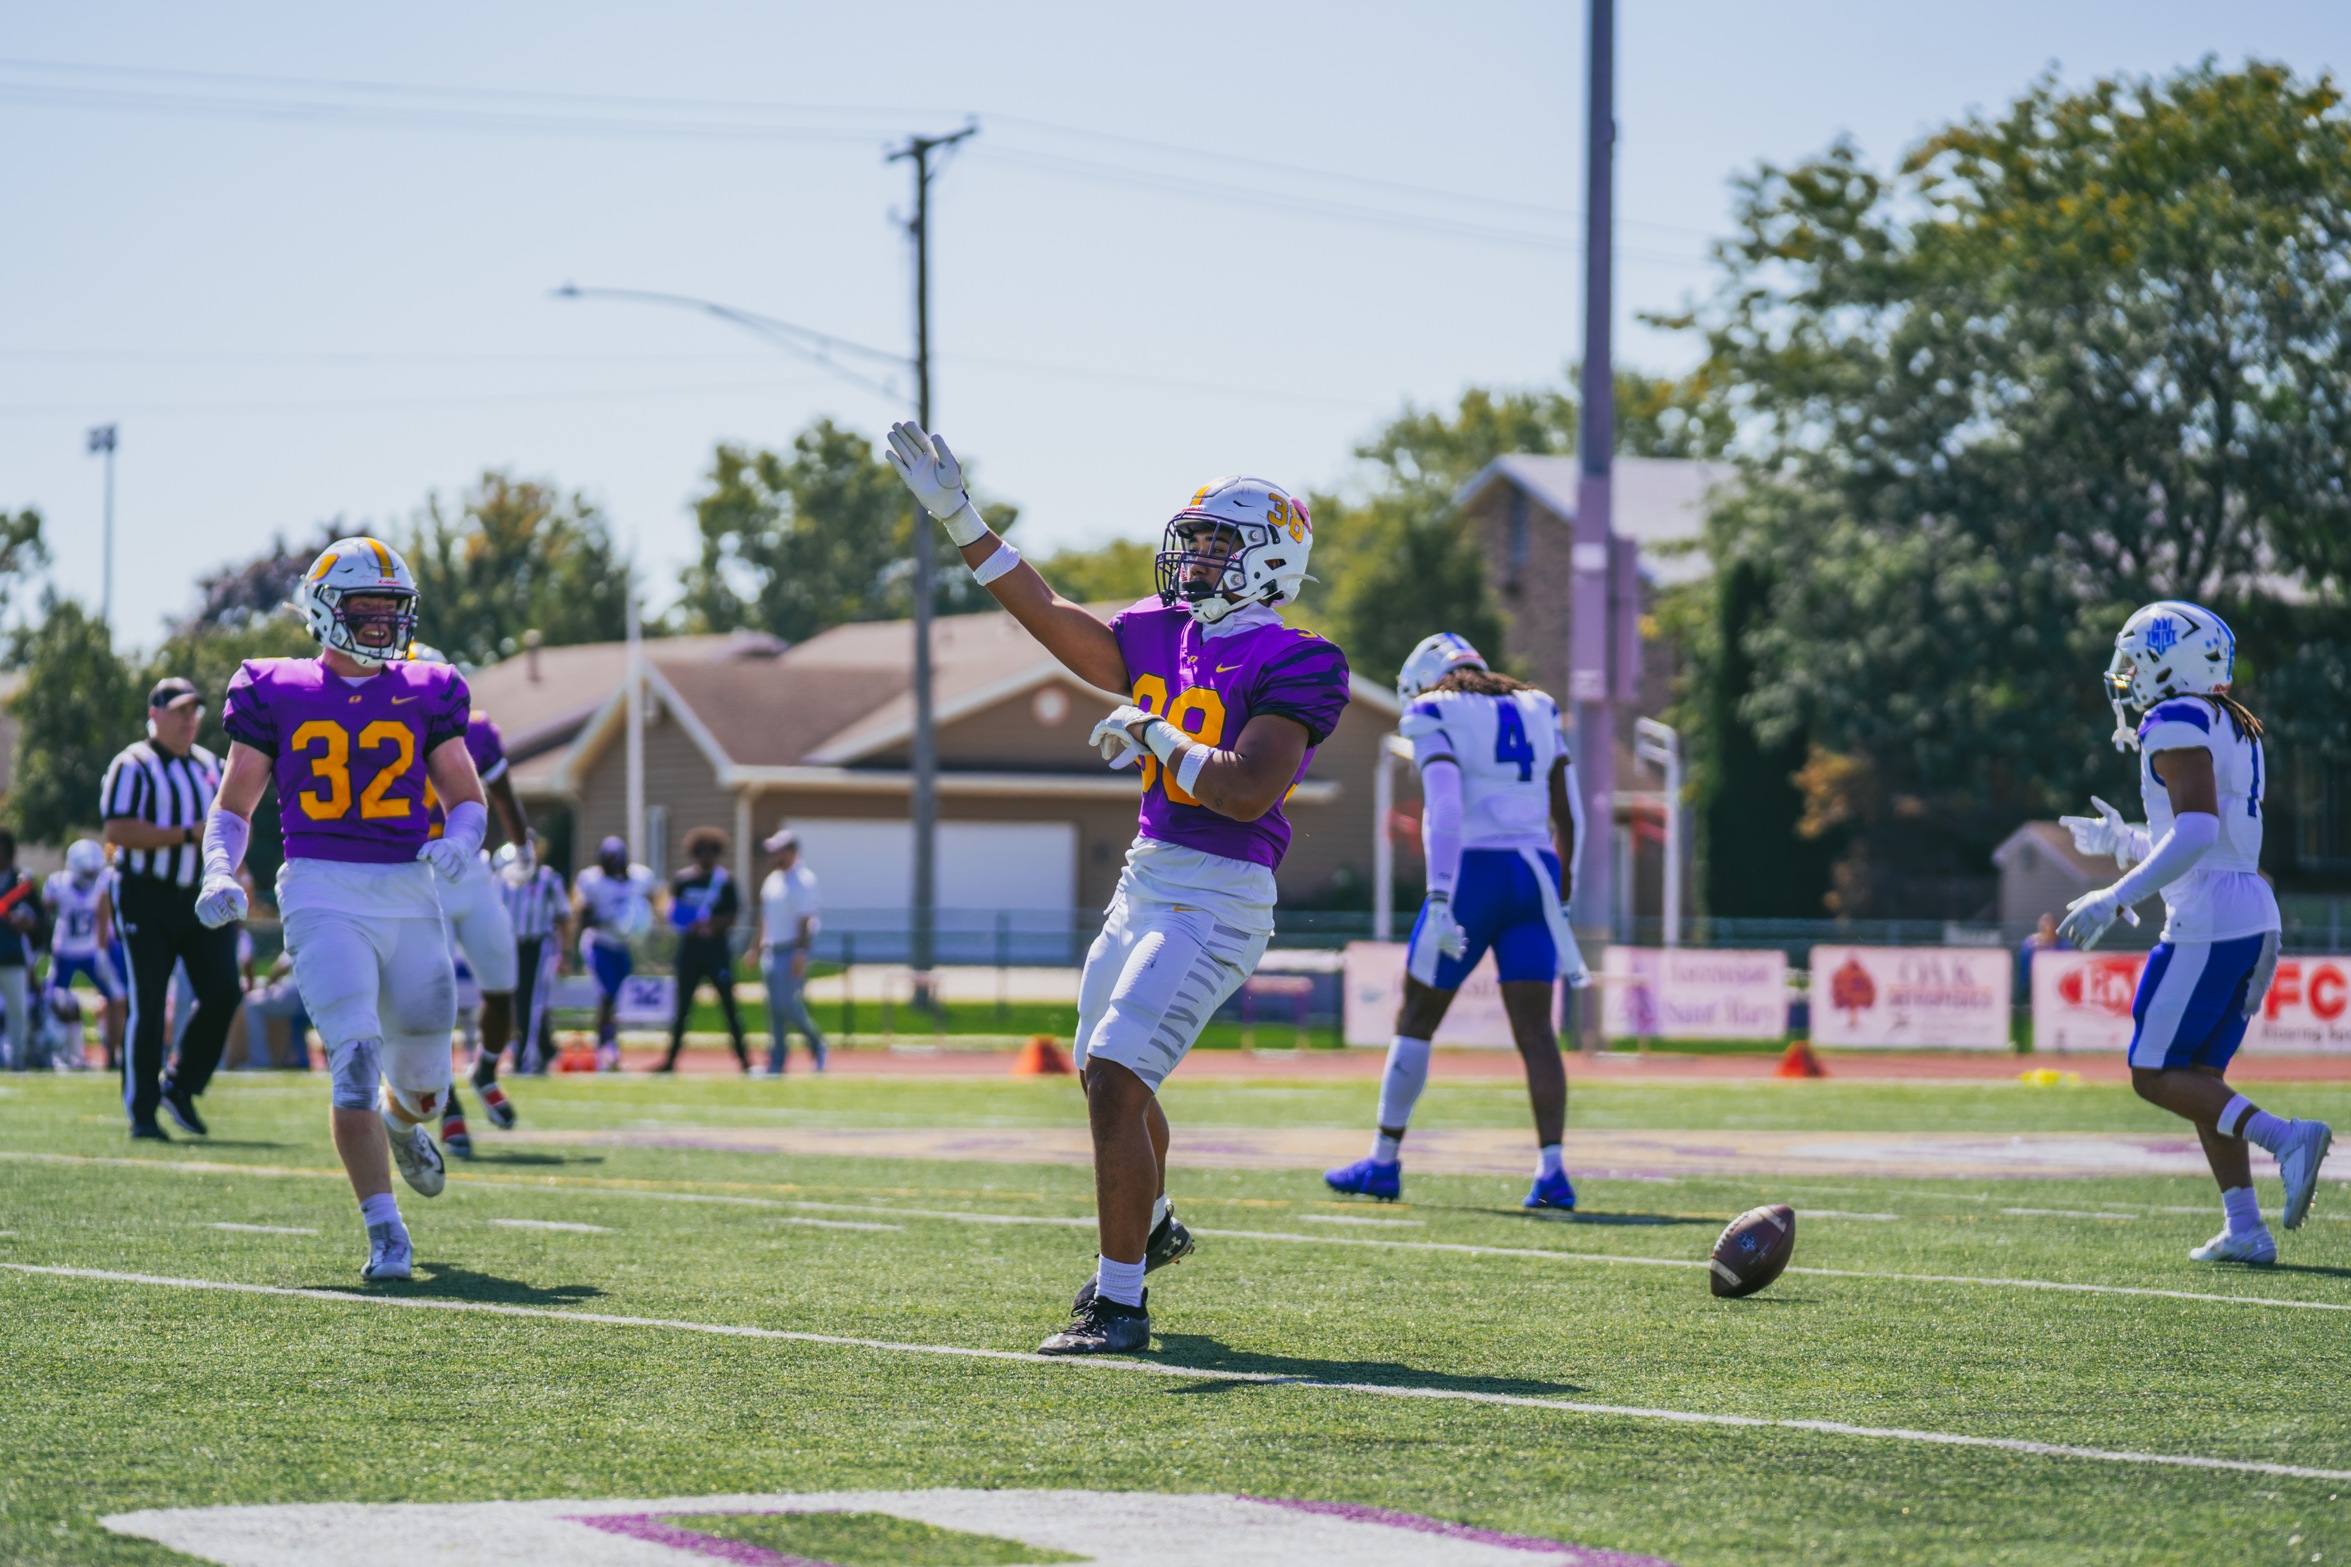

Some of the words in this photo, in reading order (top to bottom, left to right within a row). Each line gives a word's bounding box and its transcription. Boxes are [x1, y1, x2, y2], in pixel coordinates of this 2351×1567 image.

[1267, 492, 1304, 544] 38
[291, 719, 415, 821] 32
[1495, 695, 1535, 783] 4
[2264, 962, 2348, 1022] FC
